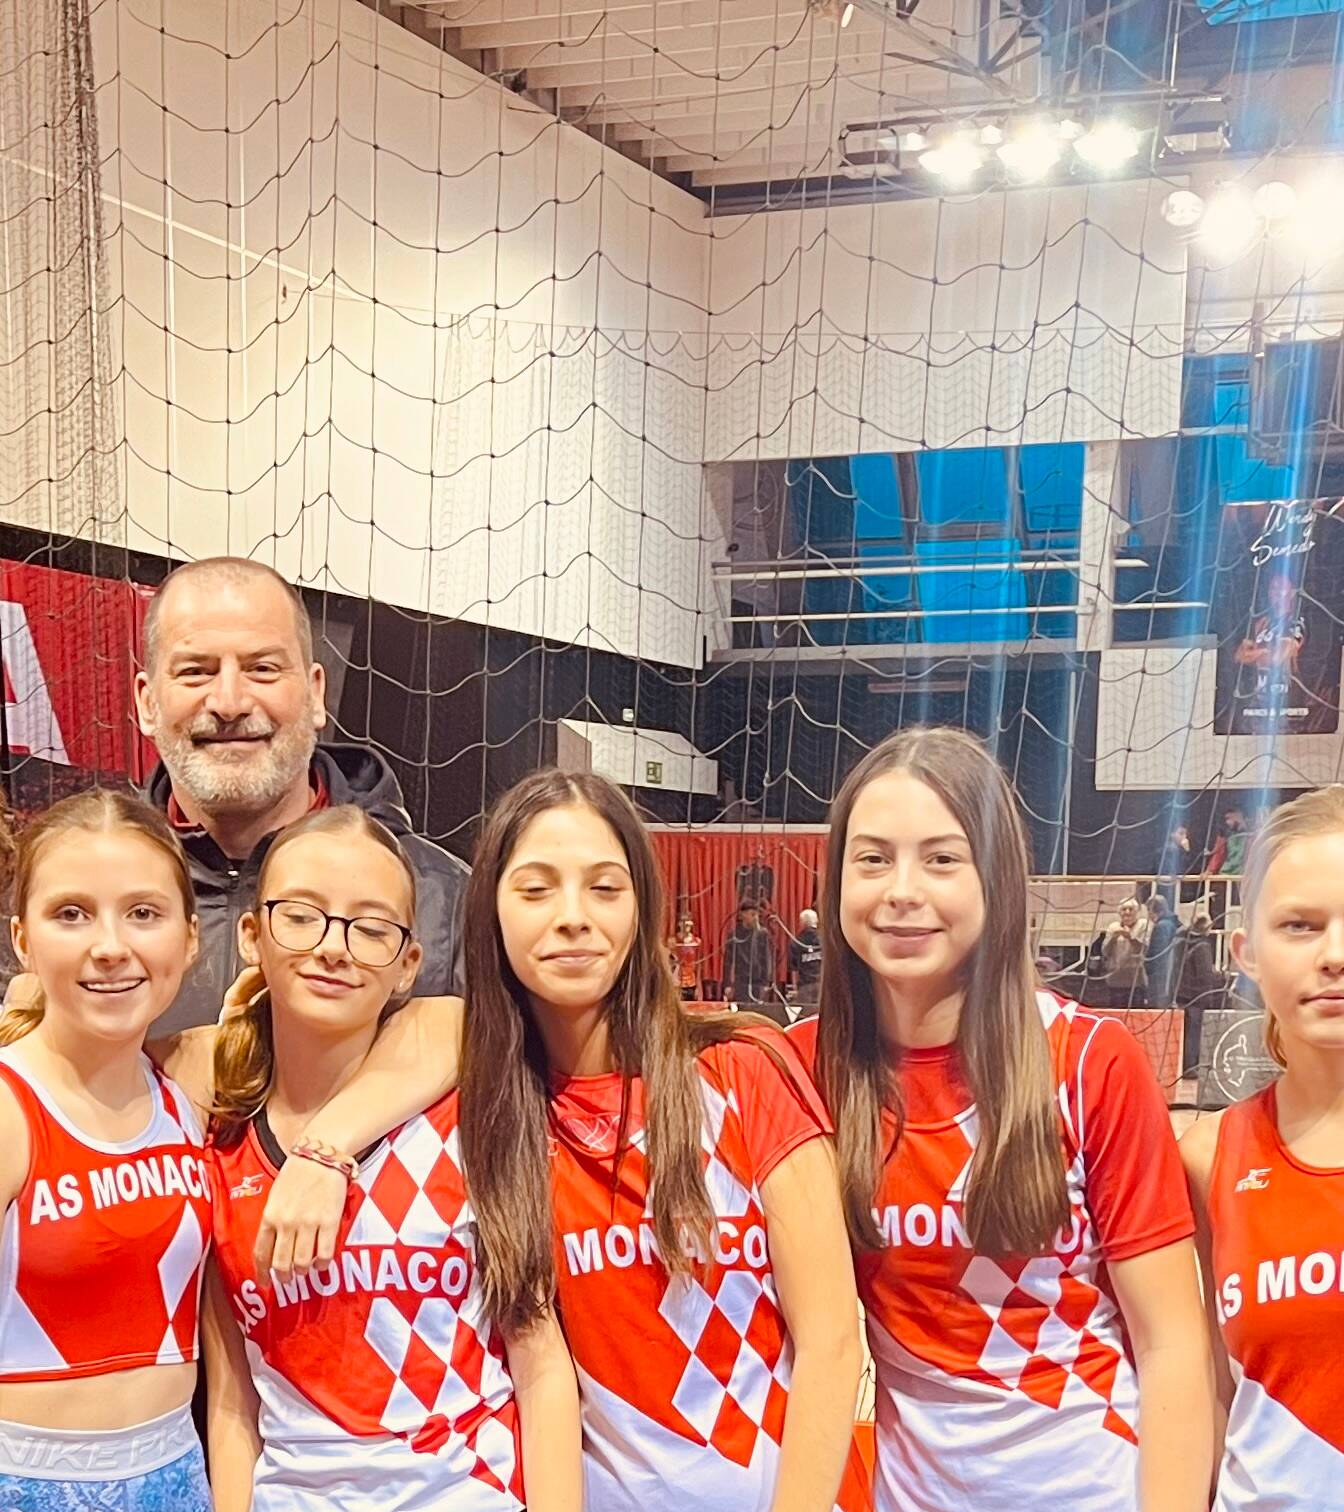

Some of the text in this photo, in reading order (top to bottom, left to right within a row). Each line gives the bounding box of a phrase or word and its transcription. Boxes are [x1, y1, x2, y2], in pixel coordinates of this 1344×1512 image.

[29, 1152, 212, 1225] AS MONACO
[270, 1249, 468, 1309] MONACO
